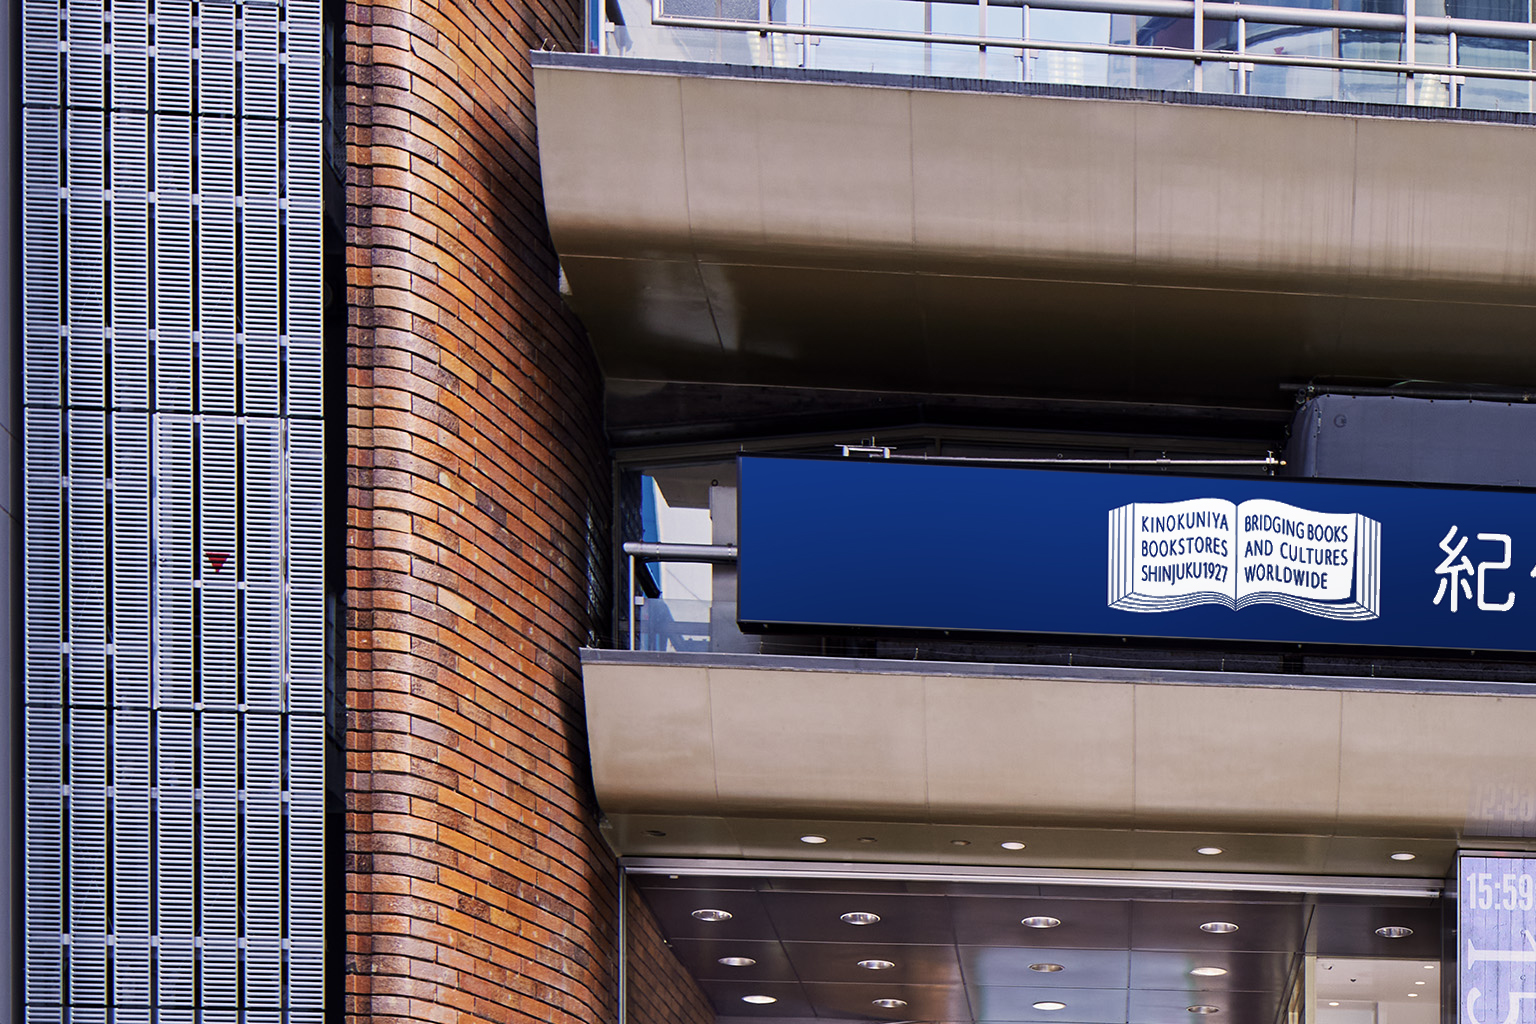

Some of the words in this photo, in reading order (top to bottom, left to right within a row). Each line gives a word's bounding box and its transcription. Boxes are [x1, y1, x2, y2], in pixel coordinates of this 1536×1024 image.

[1141, 511, 1229, 533] KINOKUNIYA
[1244, 514, 1305, 540] BRIDGING
[1307, 524, 1348, 543] BOOKS
[1141, 537, 1229, 558] BOOKSTORES
[1244, 539, 1273, 558] AND
[1280, 541, 1348, 567] CULTURES
[1244, 563, 1329, 590] WORLDWIDE
